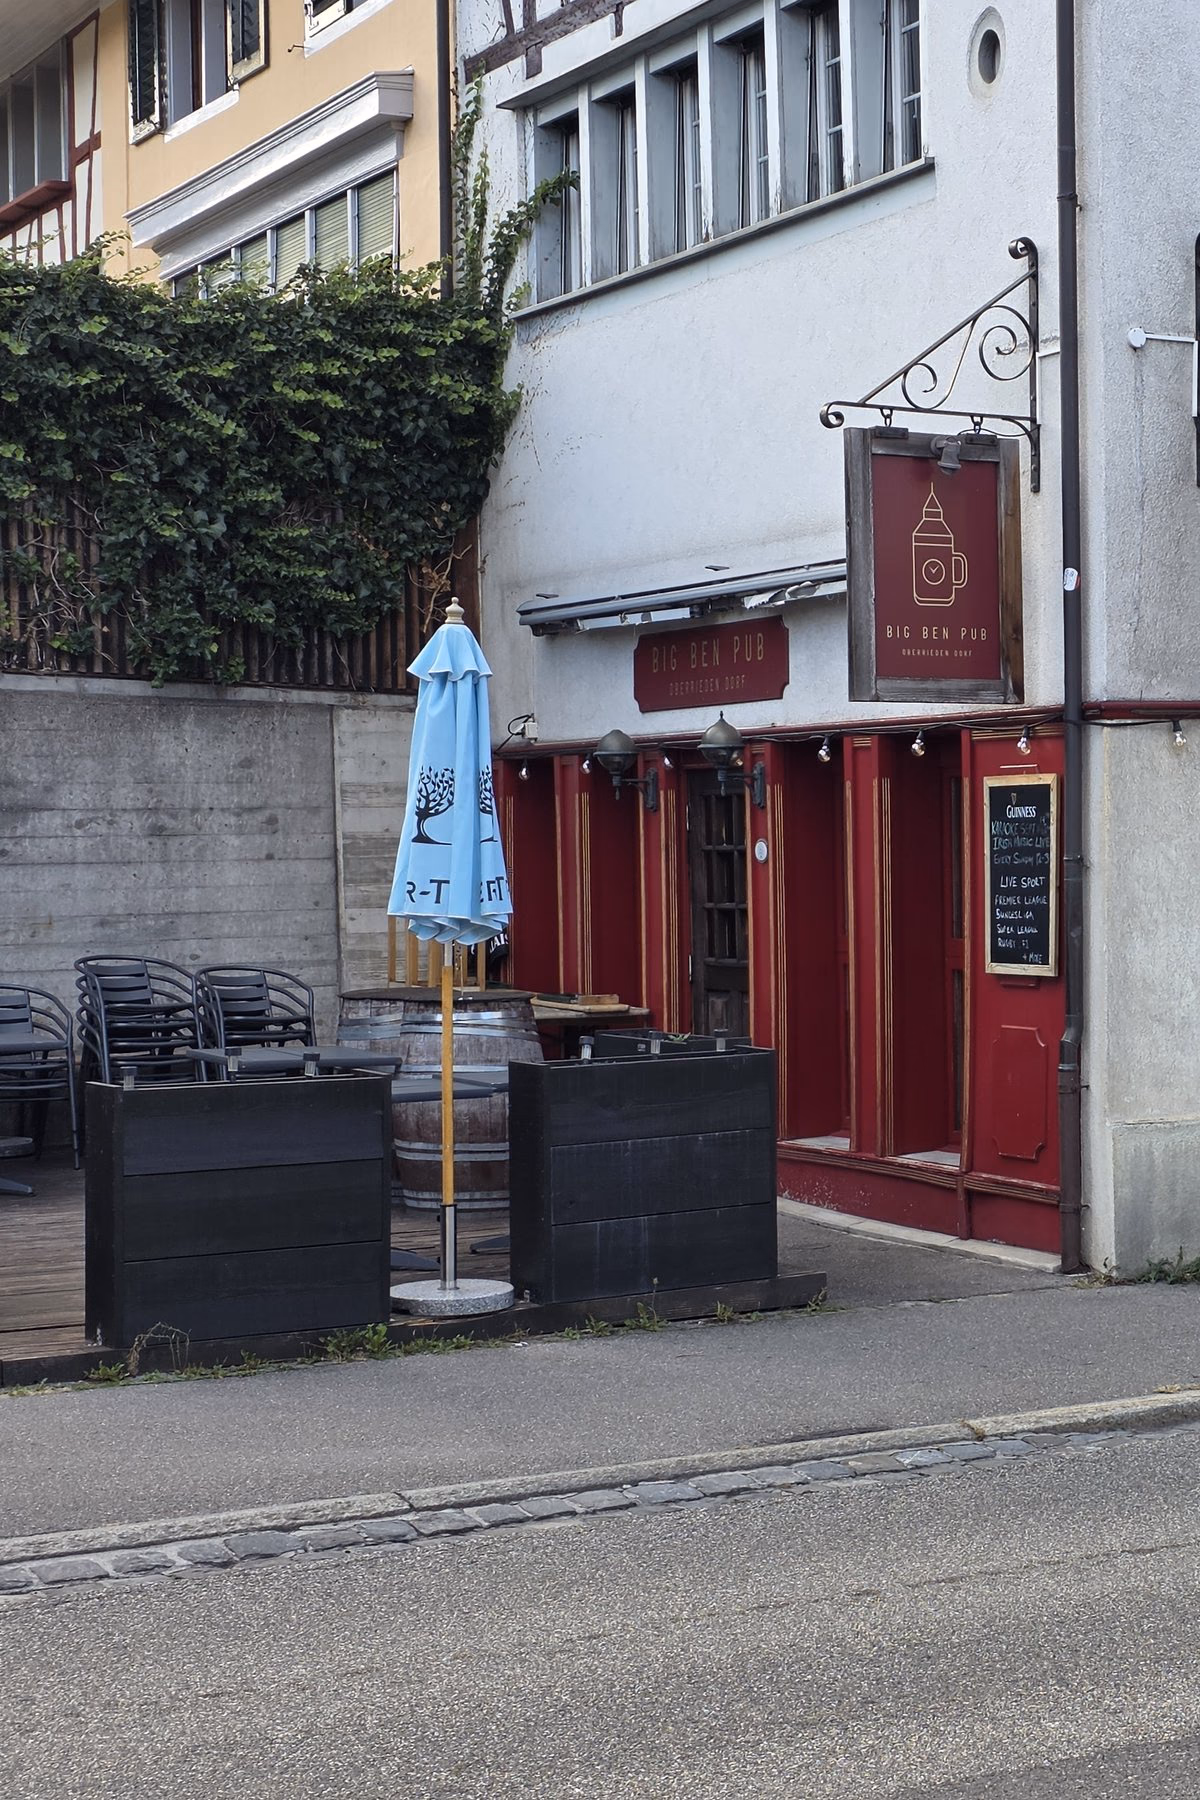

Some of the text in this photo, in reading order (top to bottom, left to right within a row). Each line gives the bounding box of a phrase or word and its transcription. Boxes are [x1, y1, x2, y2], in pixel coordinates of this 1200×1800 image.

[885, 625, 987, 641] BIG BEN PUB
[652, 632, 764, 673] BIG BEN PUB
[902, 648, 973, 657] OBERRIEDEN DORF
[669, 674, 746, 697] OBERRIEDEN DORF
[1006, 804, 1037, 819] GUINNESS
[1000, 875, 1046, 889] LIVE SPORT
[1024, 895, 1048, 905] LEAGUE
